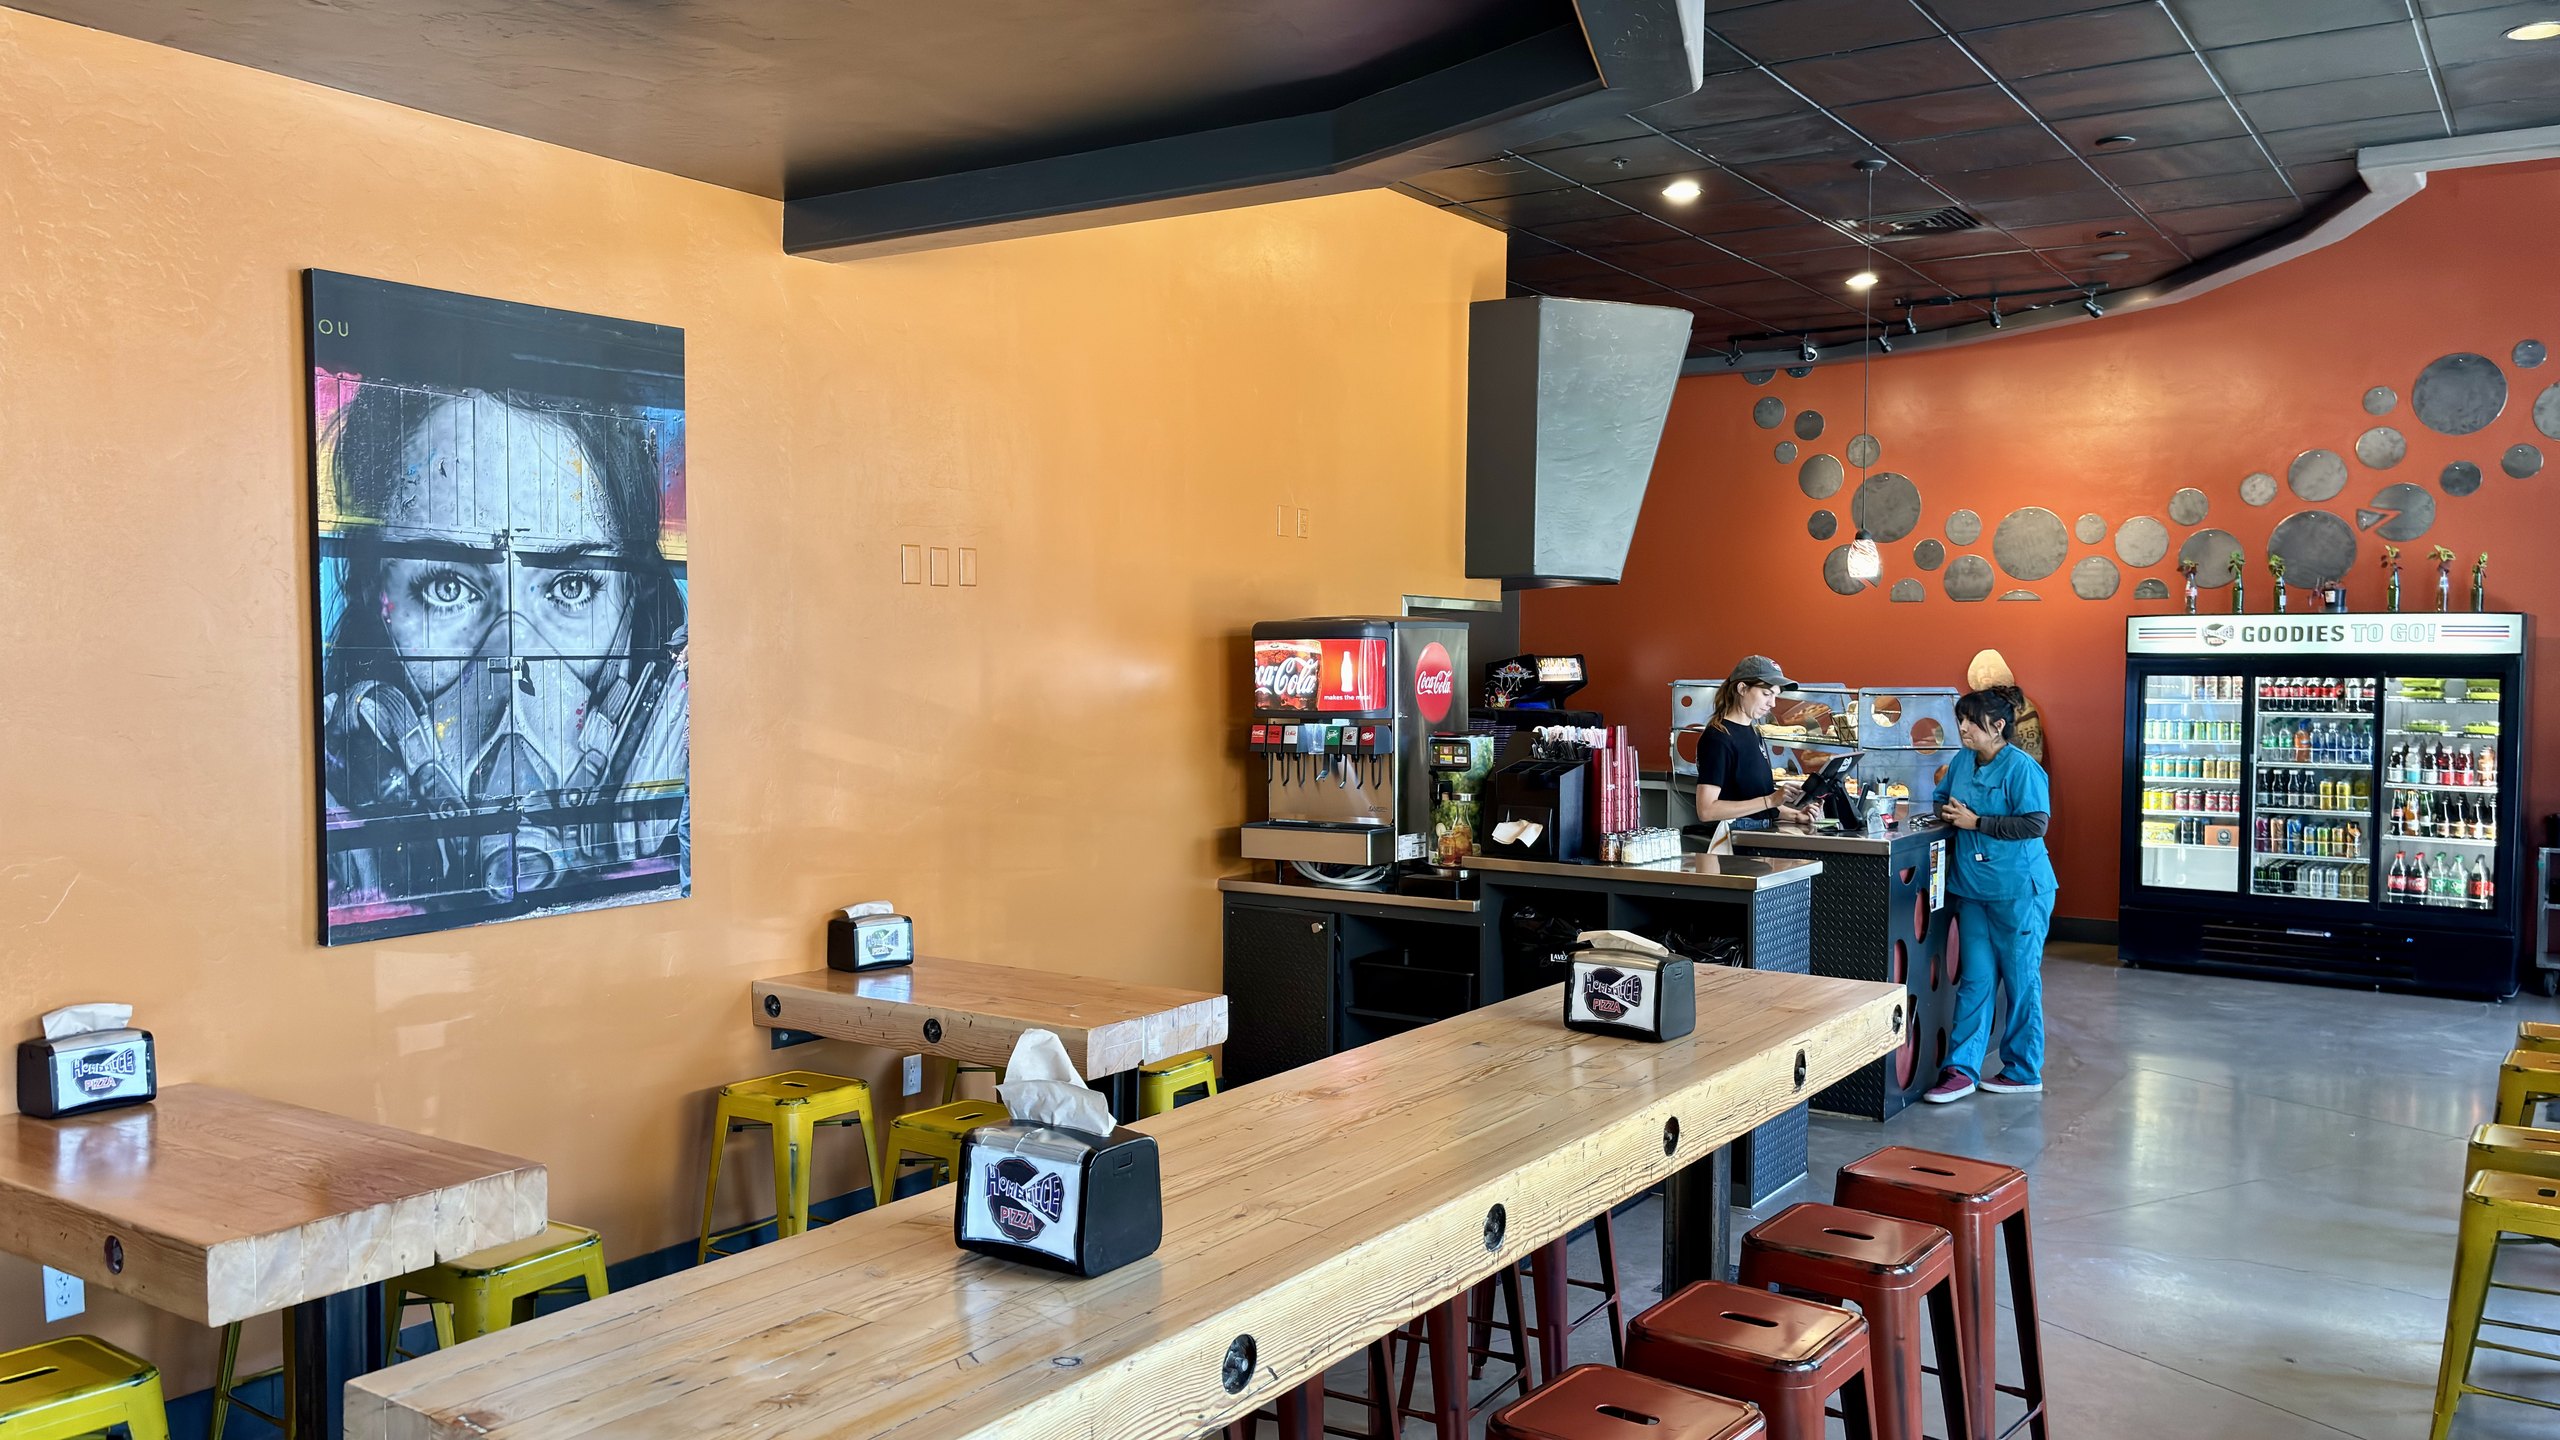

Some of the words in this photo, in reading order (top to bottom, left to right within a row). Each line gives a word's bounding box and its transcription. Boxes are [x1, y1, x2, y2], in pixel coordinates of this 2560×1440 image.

[319, 319, 349, 337] OU
[2241, 625, 2345, 643] GOODIES
[2350, 623, 2384, 643] TO
[2390, 623, 2437, 643] GO!
[1417, 670, 1453, 695] Coca-Cola
[1592, 998, 1621, 1014] PIZZA
[84, 1076, 118, 1091] PIZZA
[1000, 1205, 1036, 1232] PIZZA
